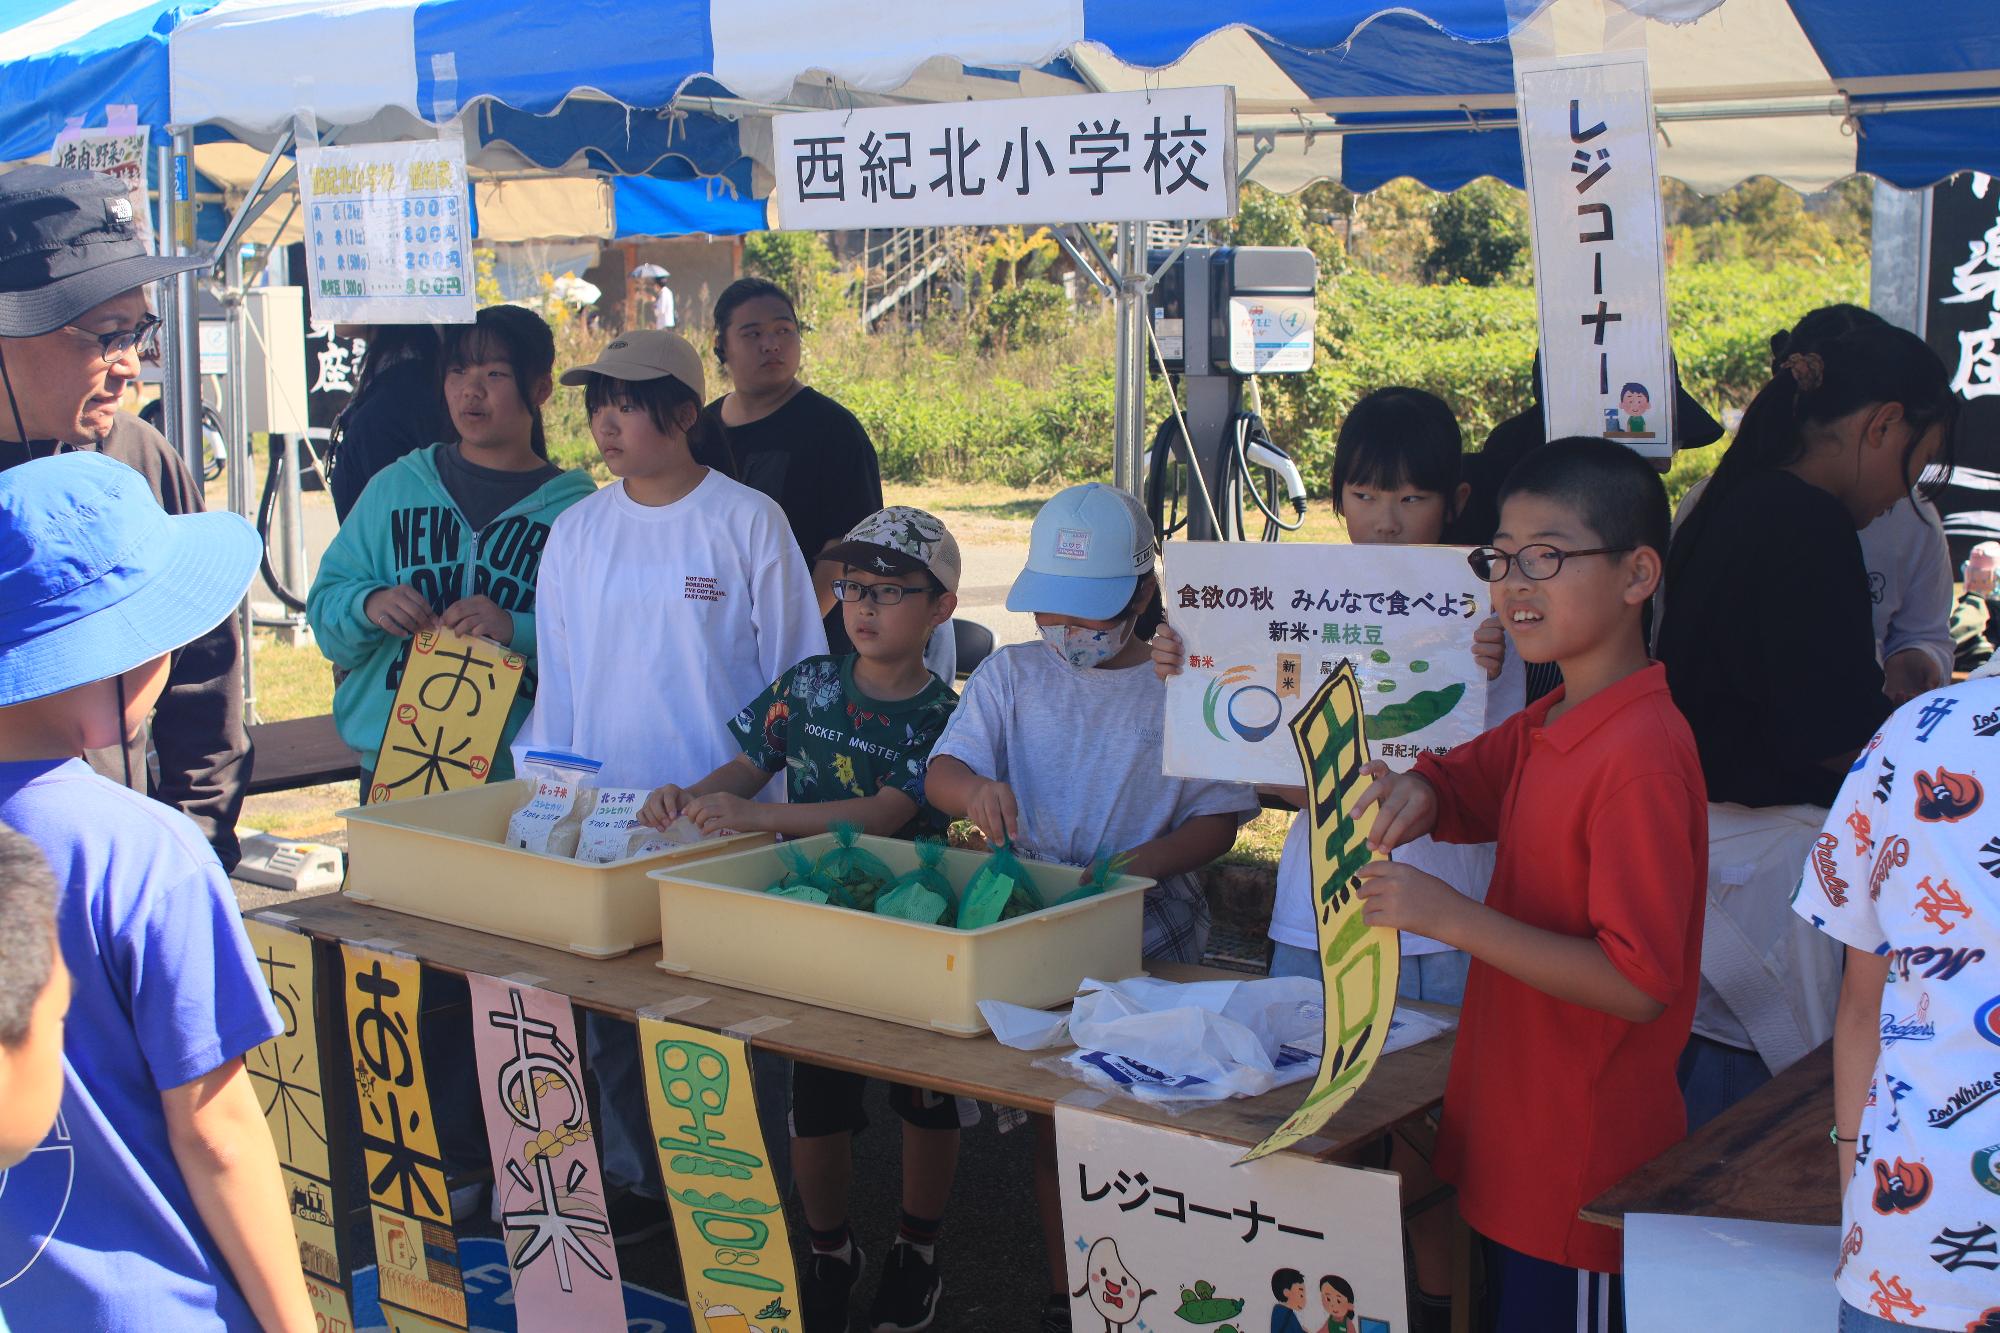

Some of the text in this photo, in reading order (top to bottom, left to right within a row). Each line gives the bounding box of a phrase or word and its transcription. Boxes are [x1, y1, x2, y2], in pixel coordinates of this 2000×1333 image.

[793, 115, 1210, 203] 西紀北小学校
[1569, 100, 1623, 395] レジコーナー
[1285, 313, 1299, 328] 4
[391, 506, 550, 585] NEW YOR
[1176, 583, 1478, 618] 食欲の秋 みんなで食べよう
[1268, 620, 1384, 646] 新米・黒枝豆
[1189, 654, 1215, 668] 新米
[1281, 659, 1297, 690] 新米
[384, 647, 497, 796] お米
[804, 722, 844, 742] POCKET
[1381, 743, 1453, 759] 西紀北小学
[595, 806, 633, 817] (コシヒカリ)
[600, 792, 636, 804] 北っ子米
[356, 959, 452, 1217] お米
[488, 987, 612, 1293] お米
[1078, 1162, 1325, 1244] レジコーナー
